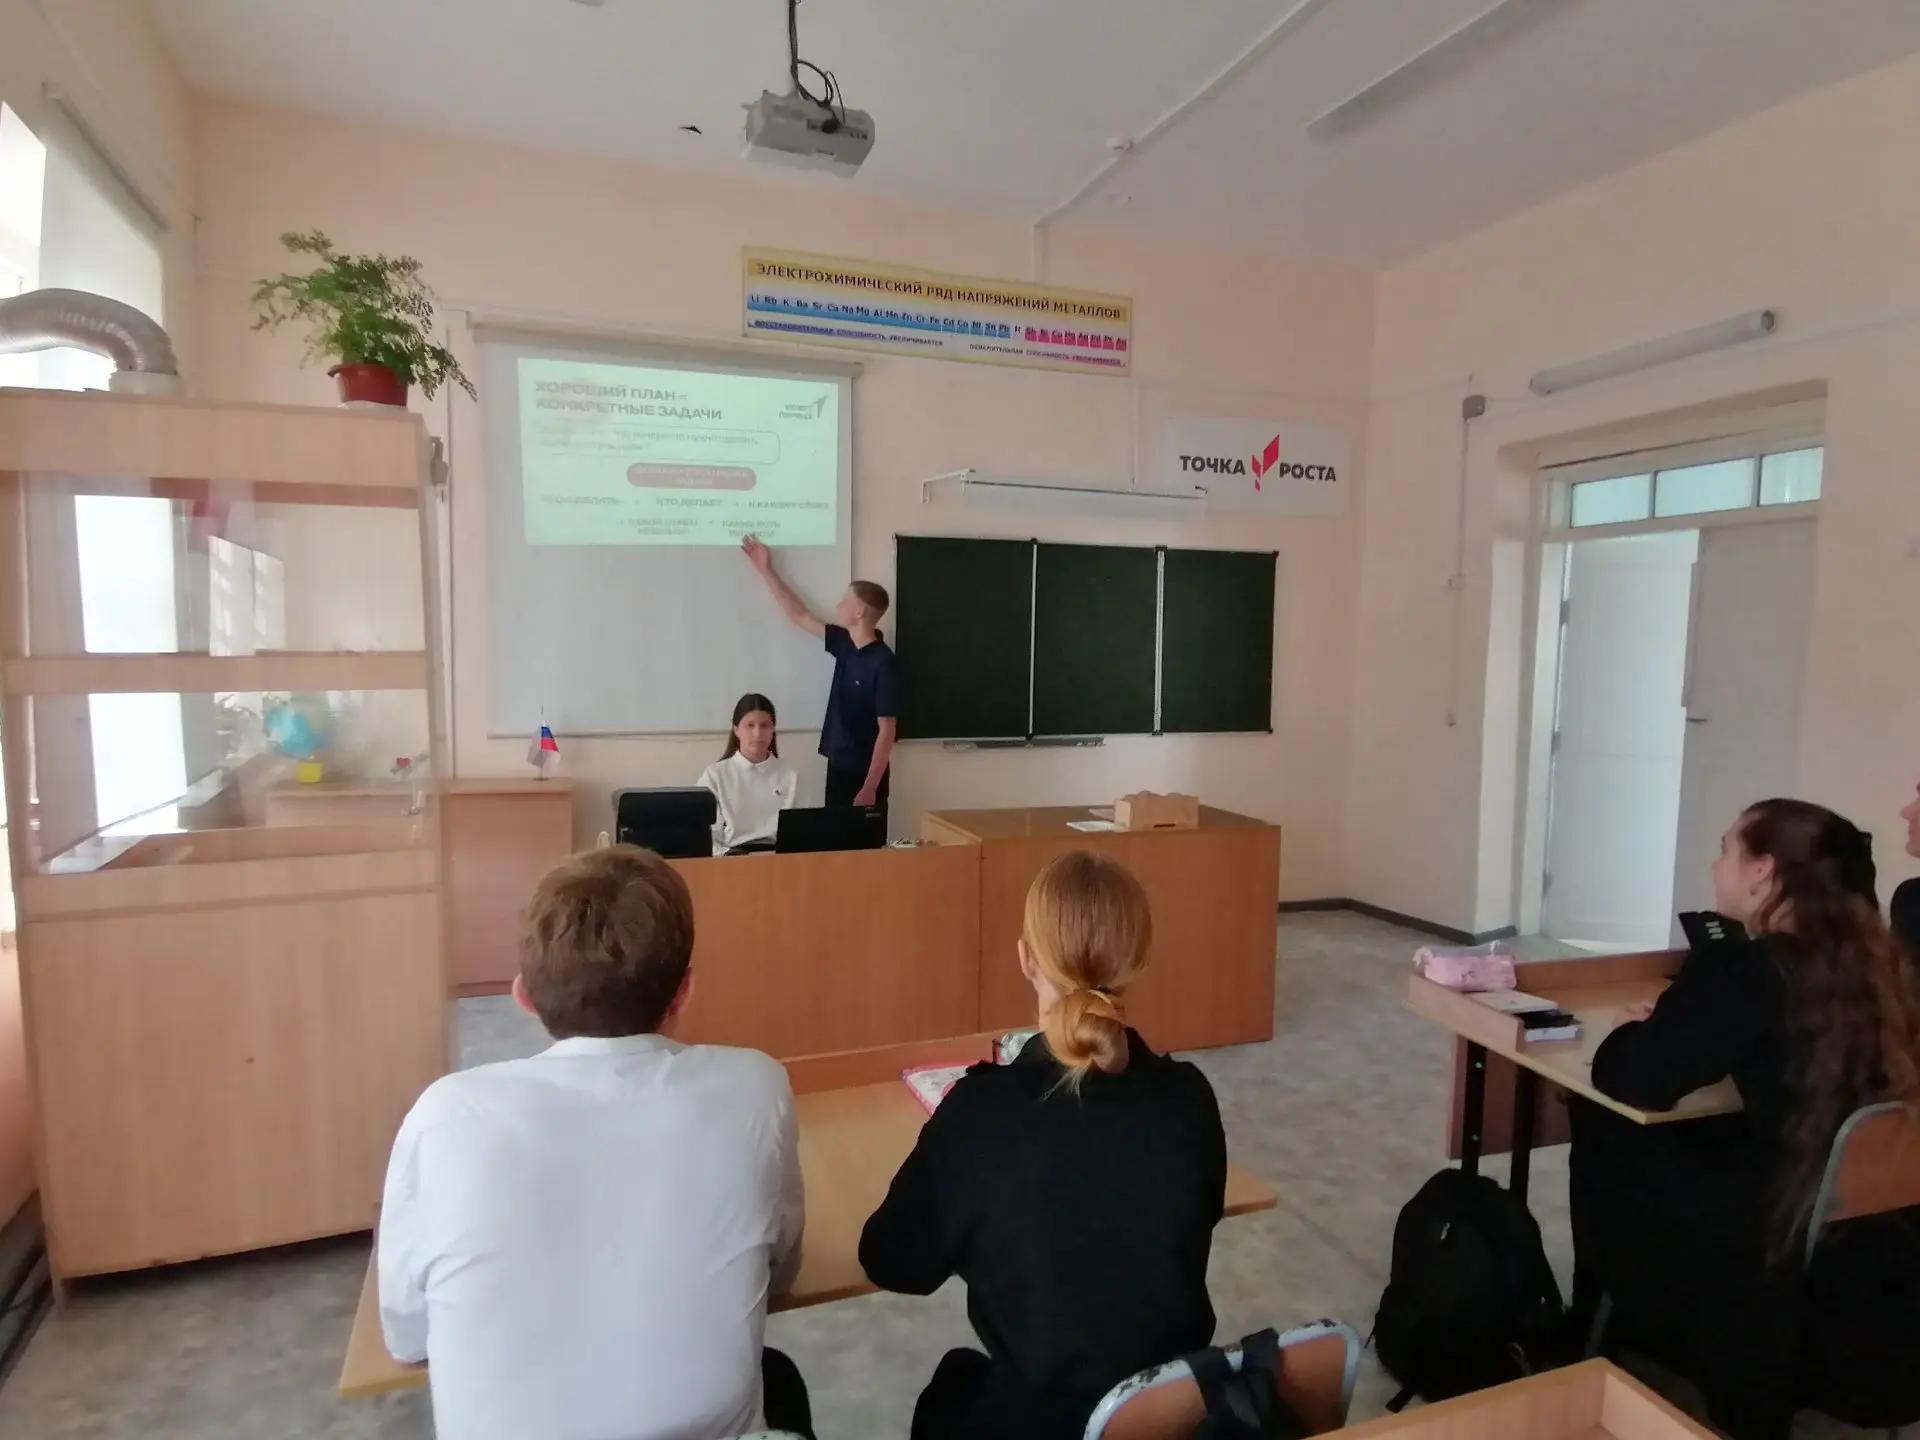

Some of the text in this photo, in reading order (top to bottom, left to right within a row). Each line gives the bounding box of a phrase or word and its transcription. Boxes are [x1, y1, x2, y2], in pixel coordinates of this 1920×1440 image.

[756, 263, 1121, 319] ЭЛЕКТРОХИМИЧЕСКИЙ РЯД НАПРЯЖЕНИЙ МЕТАЛЛОВ
[751, 295, 759, 303] Li
[764, 296, 777, 305] Rb
[783, 298, 790, 307] K
[796, 300, 808, 309] Ba
[812, 302, 823, 310] Sr
[827, 303, 839, 312] Ca
[841, 305, 854, 314] Na
[856, 306, 870, 316] Mg
[874, 309, 883, 317] Al
[886, 310, 899, 319] Mn
[534, 379, 627, 398] ХОРОШИЙ
[631, 388, 675, 401] ПЛАН
[536, 398, 723, 420] КОНКРЕТНЫЕ ЗАДАЧИ
[1180, 455, 1337, 482] ТОЧКА РОСТА
